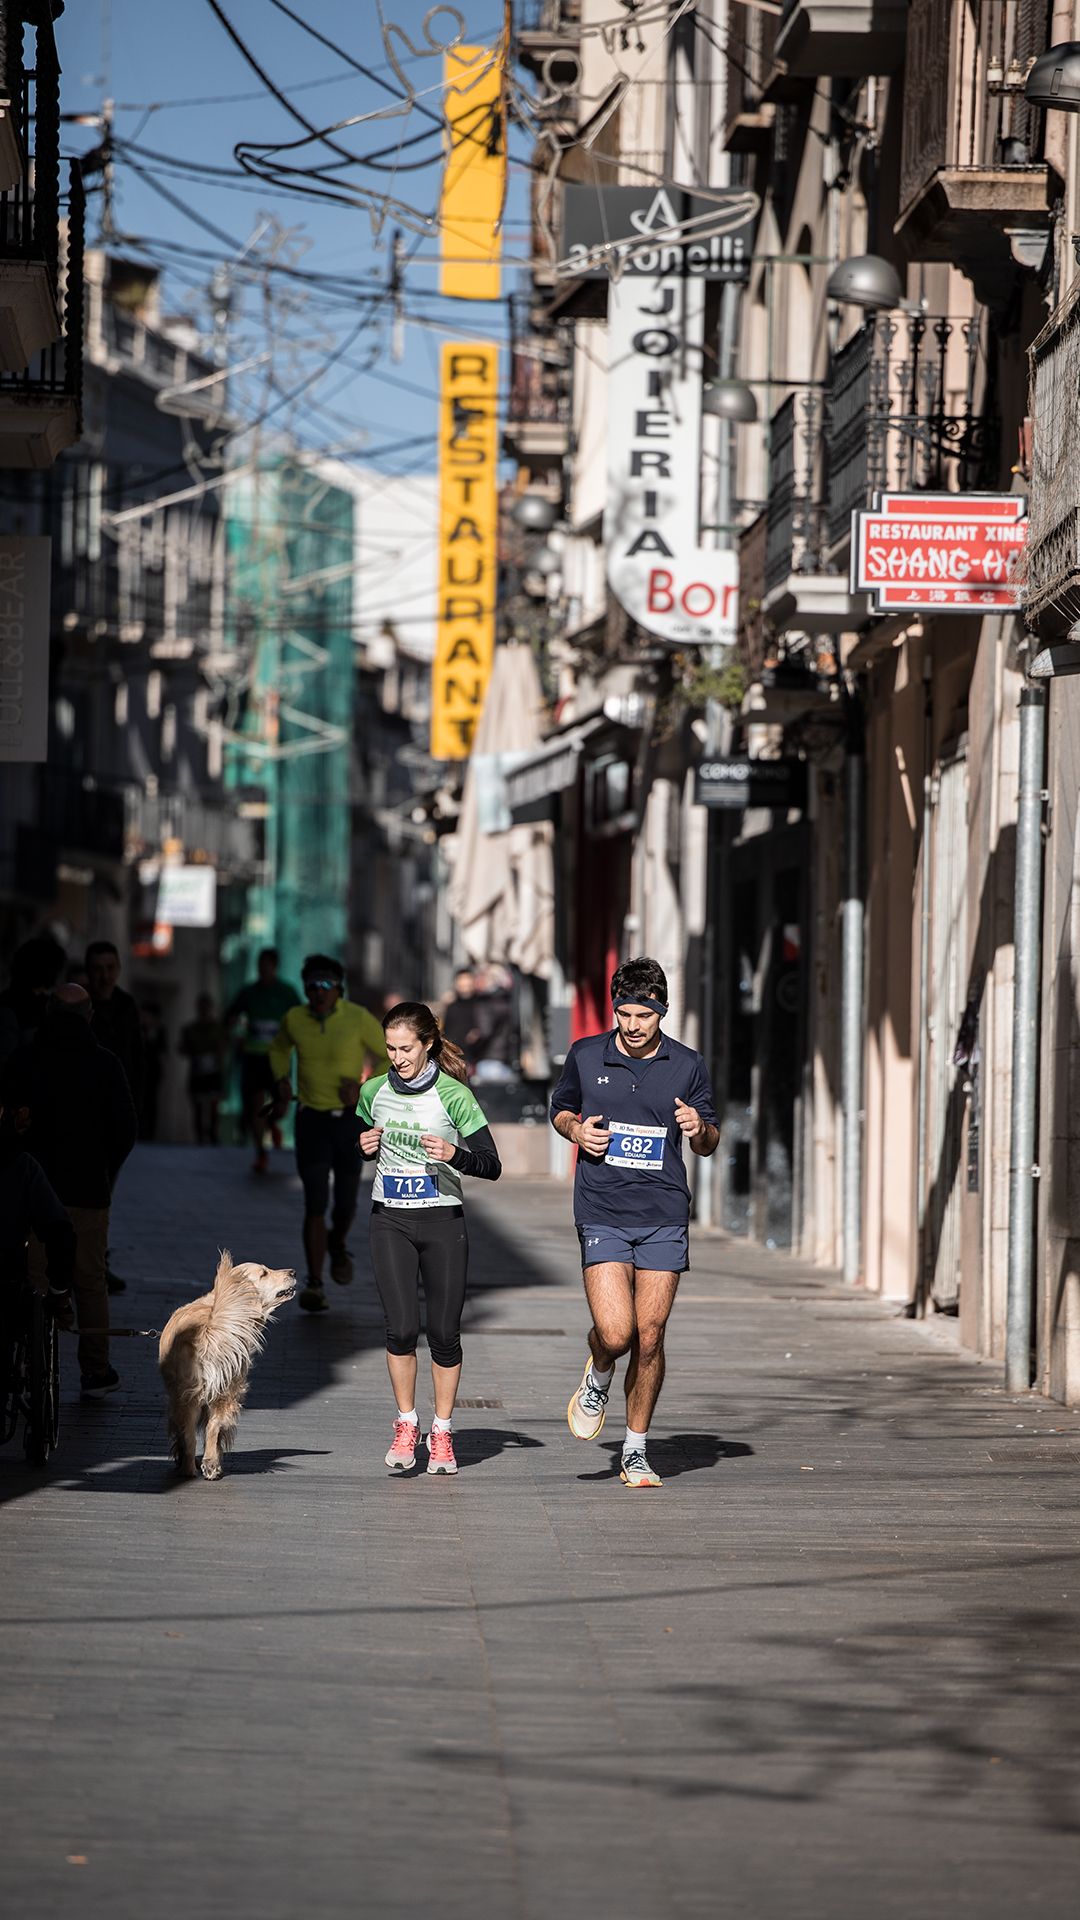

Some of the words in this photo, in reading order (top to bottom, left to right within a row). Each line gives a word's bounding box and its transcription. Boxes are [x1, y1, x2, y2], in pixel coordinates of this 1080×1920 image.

[625, 288, 680, 557] JOIERIA
[869, 523, 979, 542] RESTAURANT
[445, 353, 489, 745] RESTAURANT
[620, 1137, 653, 1154] 682
[394, 1178, 426, 1194] 712
